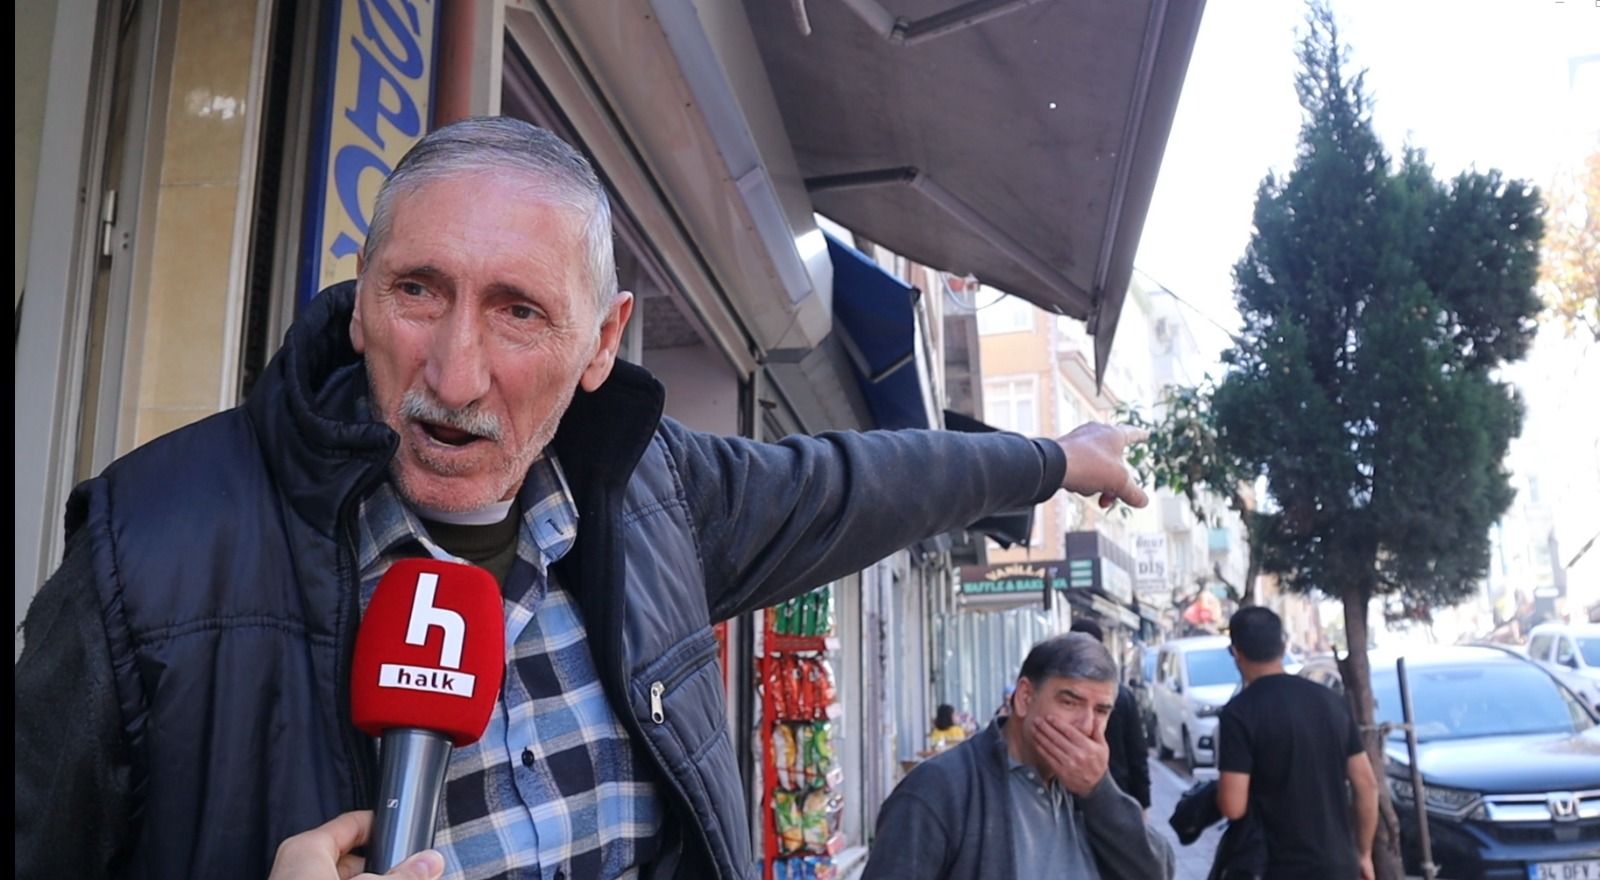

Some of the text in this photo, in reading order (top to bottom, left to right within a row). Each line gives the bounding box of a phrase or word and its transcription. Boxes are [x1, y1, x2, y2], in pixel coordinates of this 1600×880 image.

[962, 581, 1004, 594] WAFFLE
[1005, 580, 1015, 592] &
[396, 668, 456, 692] halk
